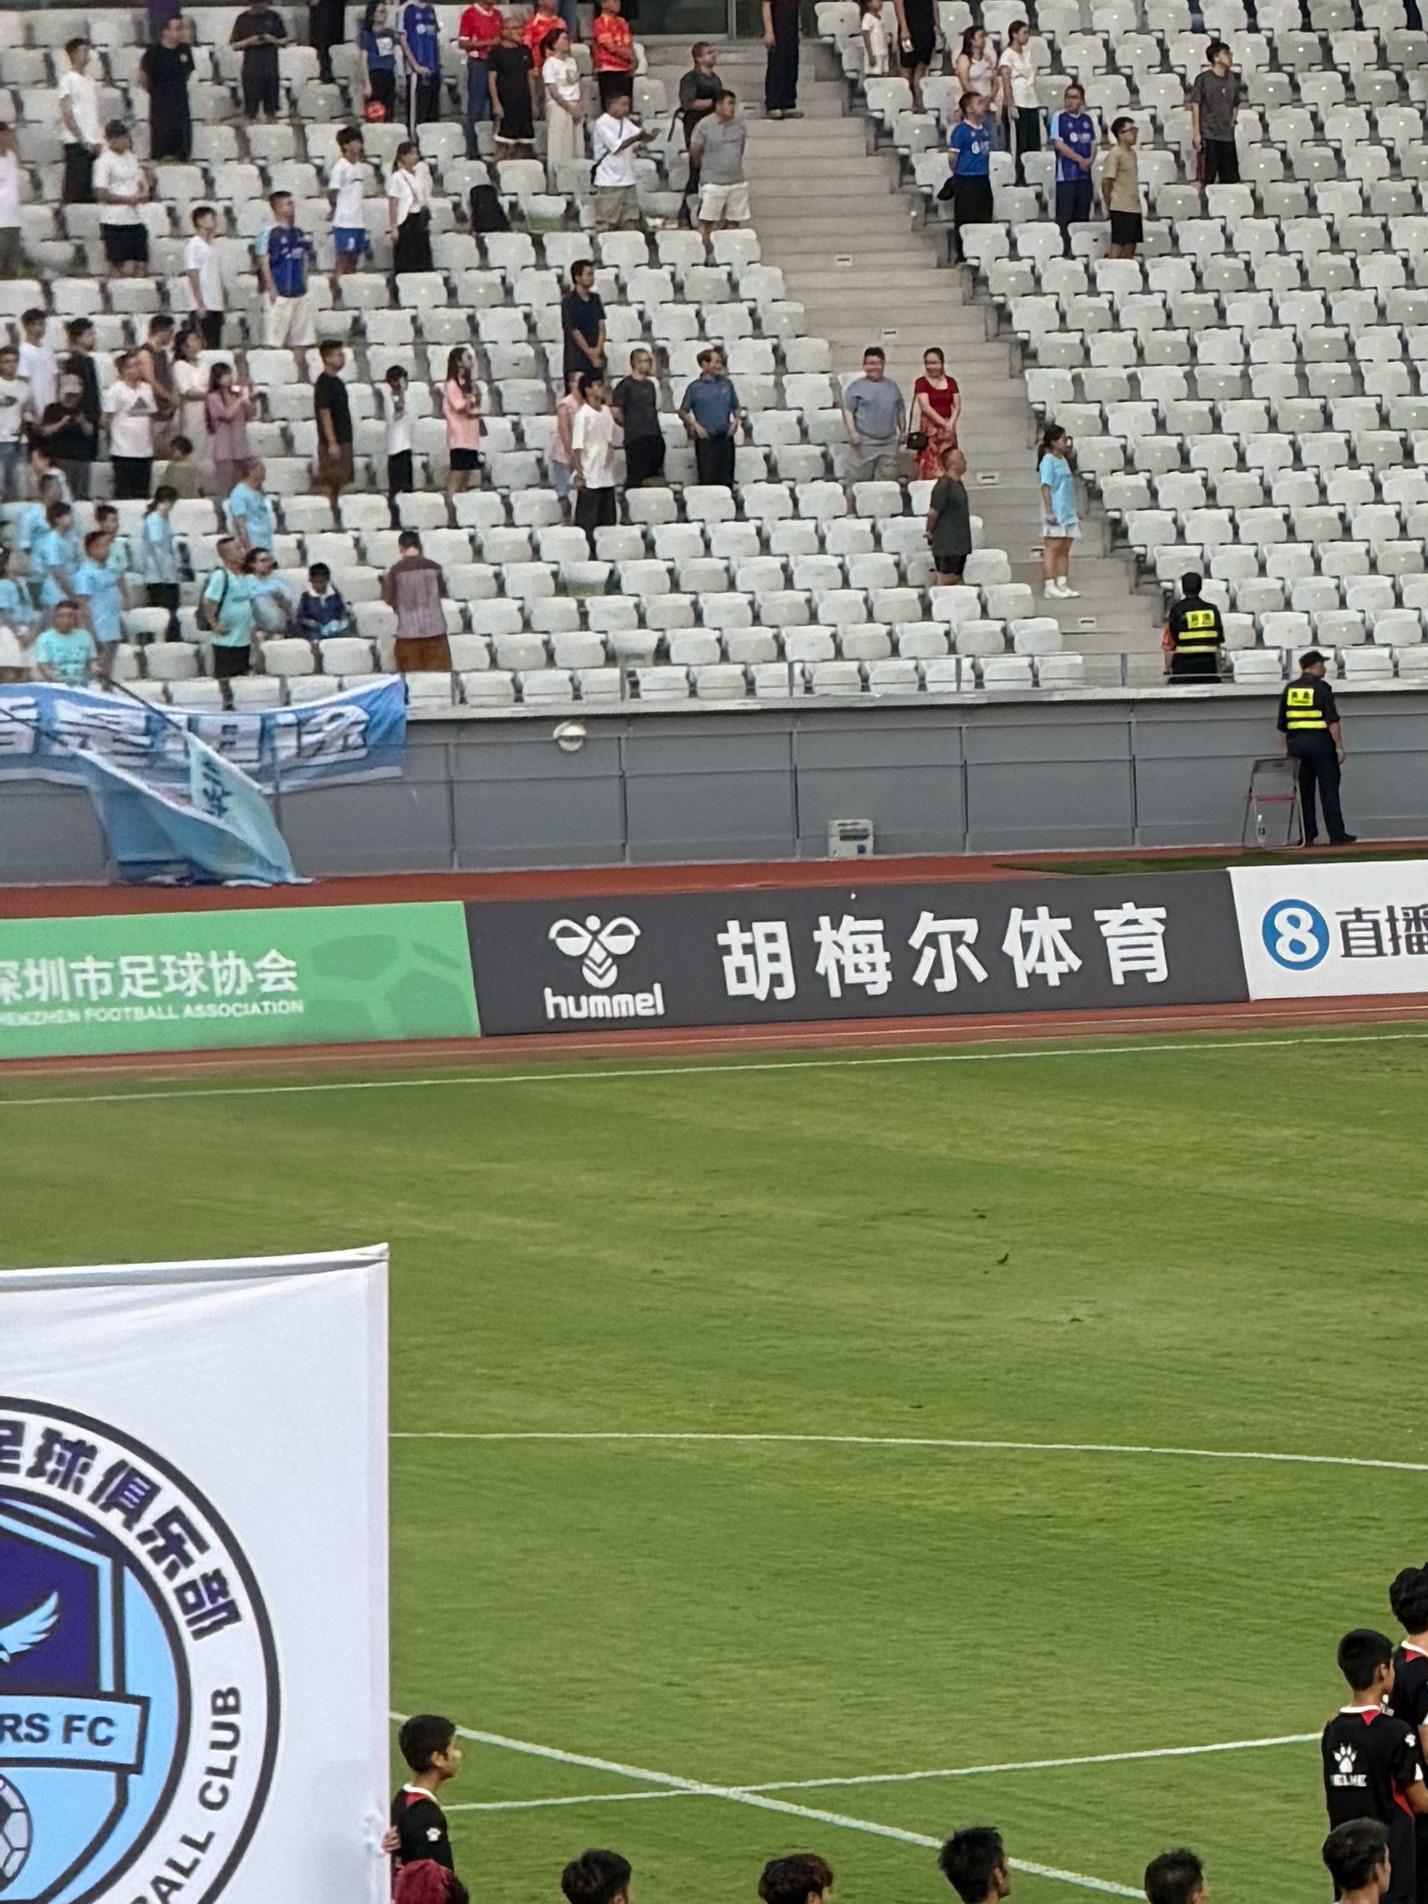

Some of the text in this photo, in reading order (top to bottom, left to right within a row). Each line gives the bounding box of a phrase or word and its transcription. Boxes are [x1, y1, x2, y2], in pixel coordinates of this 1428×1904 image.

[716, 901, 1170, 1001] 胡梅尔体育
[84, 1002, 179, 1024] FOOTBALL
[182, 998, 304, 1020] ASSOCIATION
[545, 982, 665, 1020] hummel
[62, 1714, 115, 1747] FC
[198, 1686, 242, 1811] CLUB
